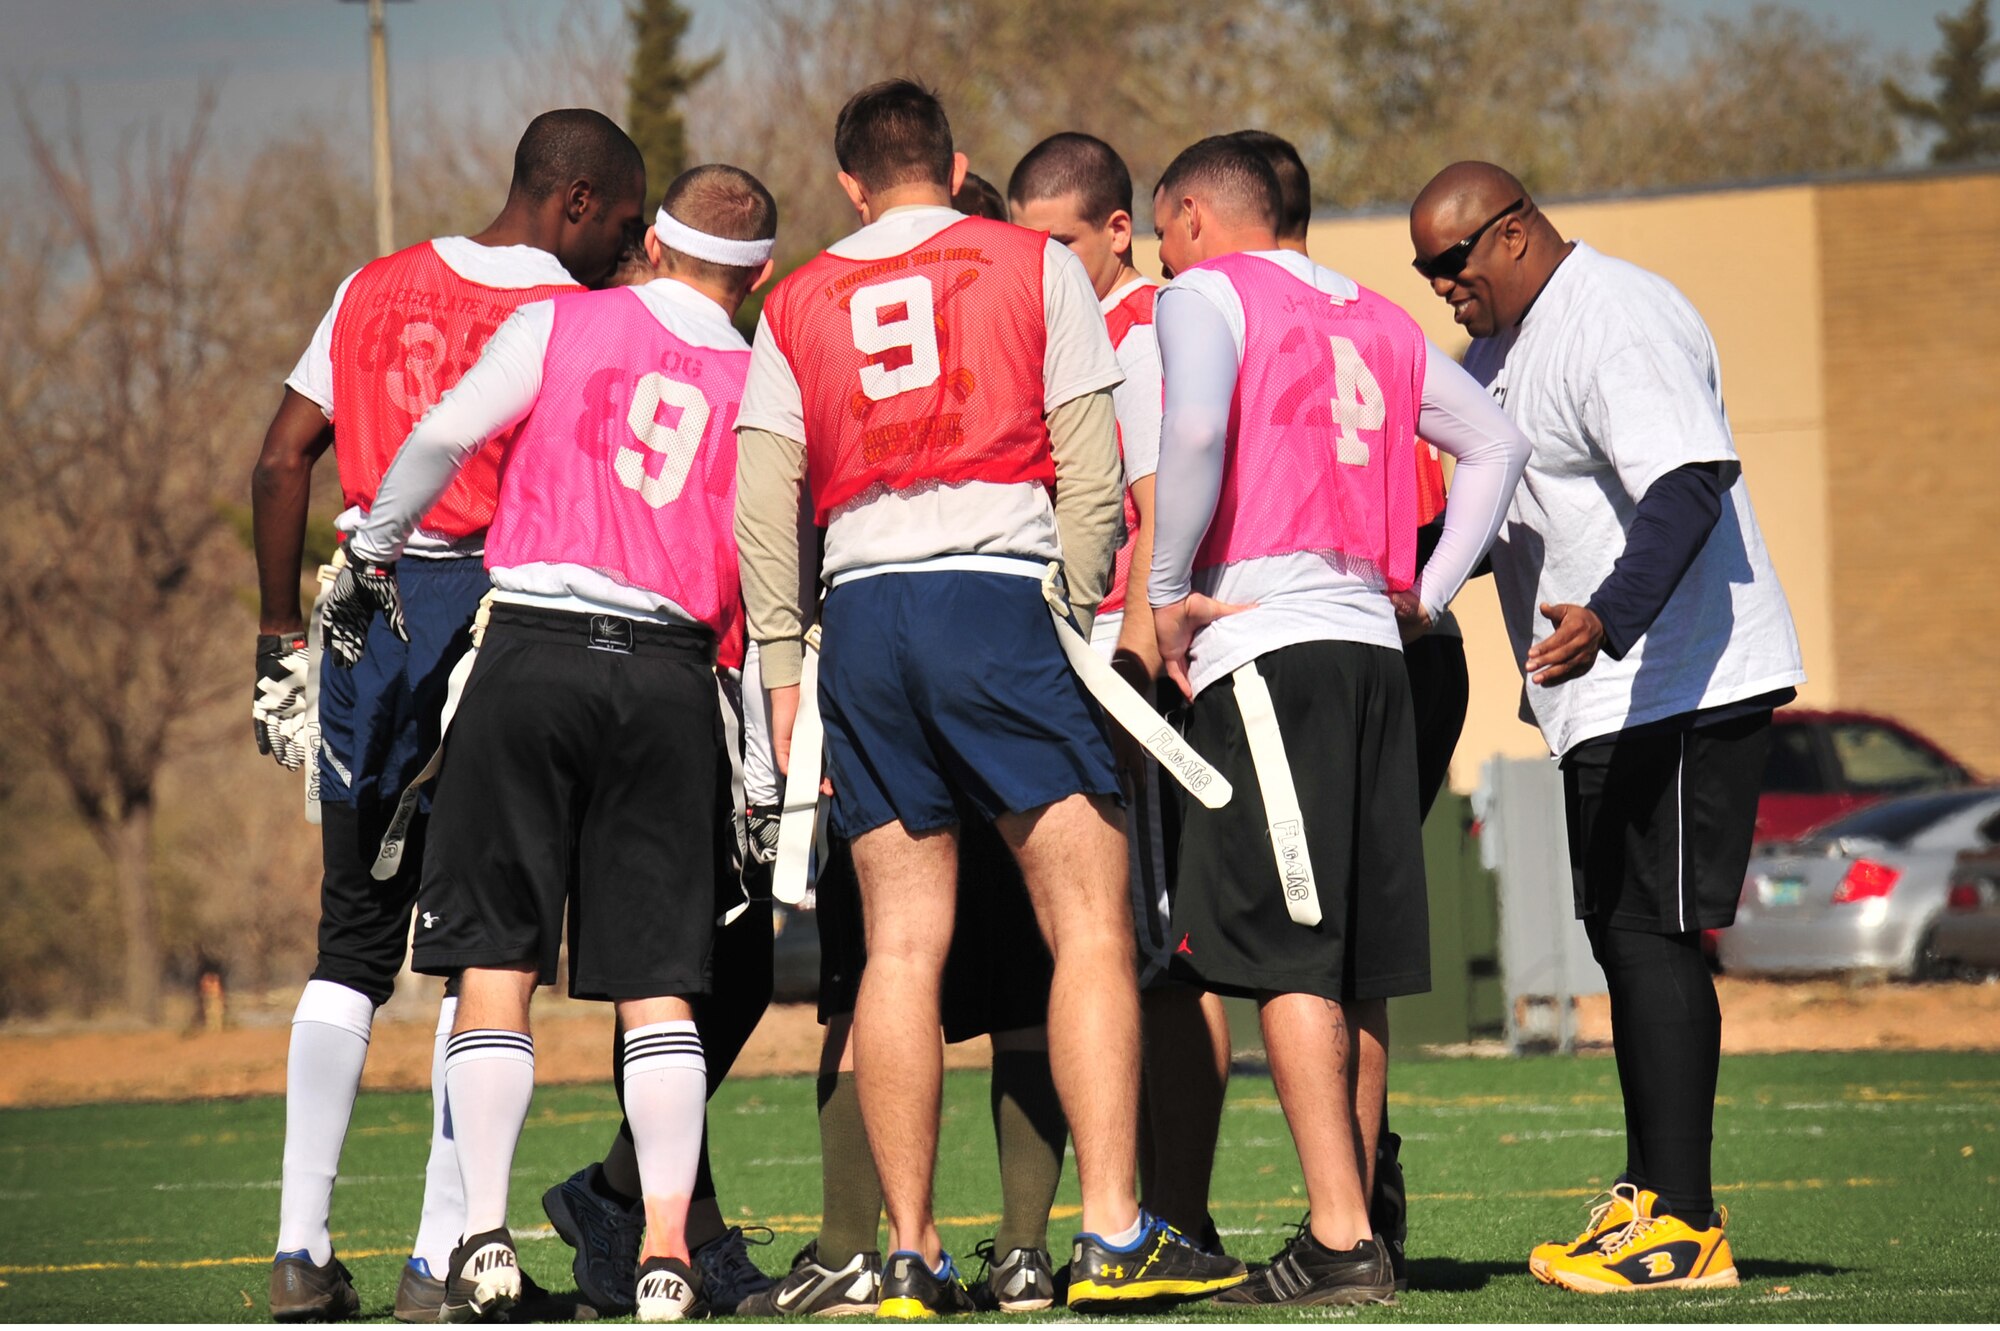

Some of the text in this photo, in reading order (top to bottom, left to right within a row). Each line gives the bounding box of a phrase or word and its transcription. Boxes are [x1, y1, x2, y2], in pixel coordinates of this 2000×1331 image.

[660, 350, 702, 378] OG
[850, 275, 941, 401] 9
[1329, 335, 1385, 466] 4
[613, 371, 710, 509] 9
[474, 1250, 515, 1277] NIKE
[640, 1277, 684, 1301] NIKE
